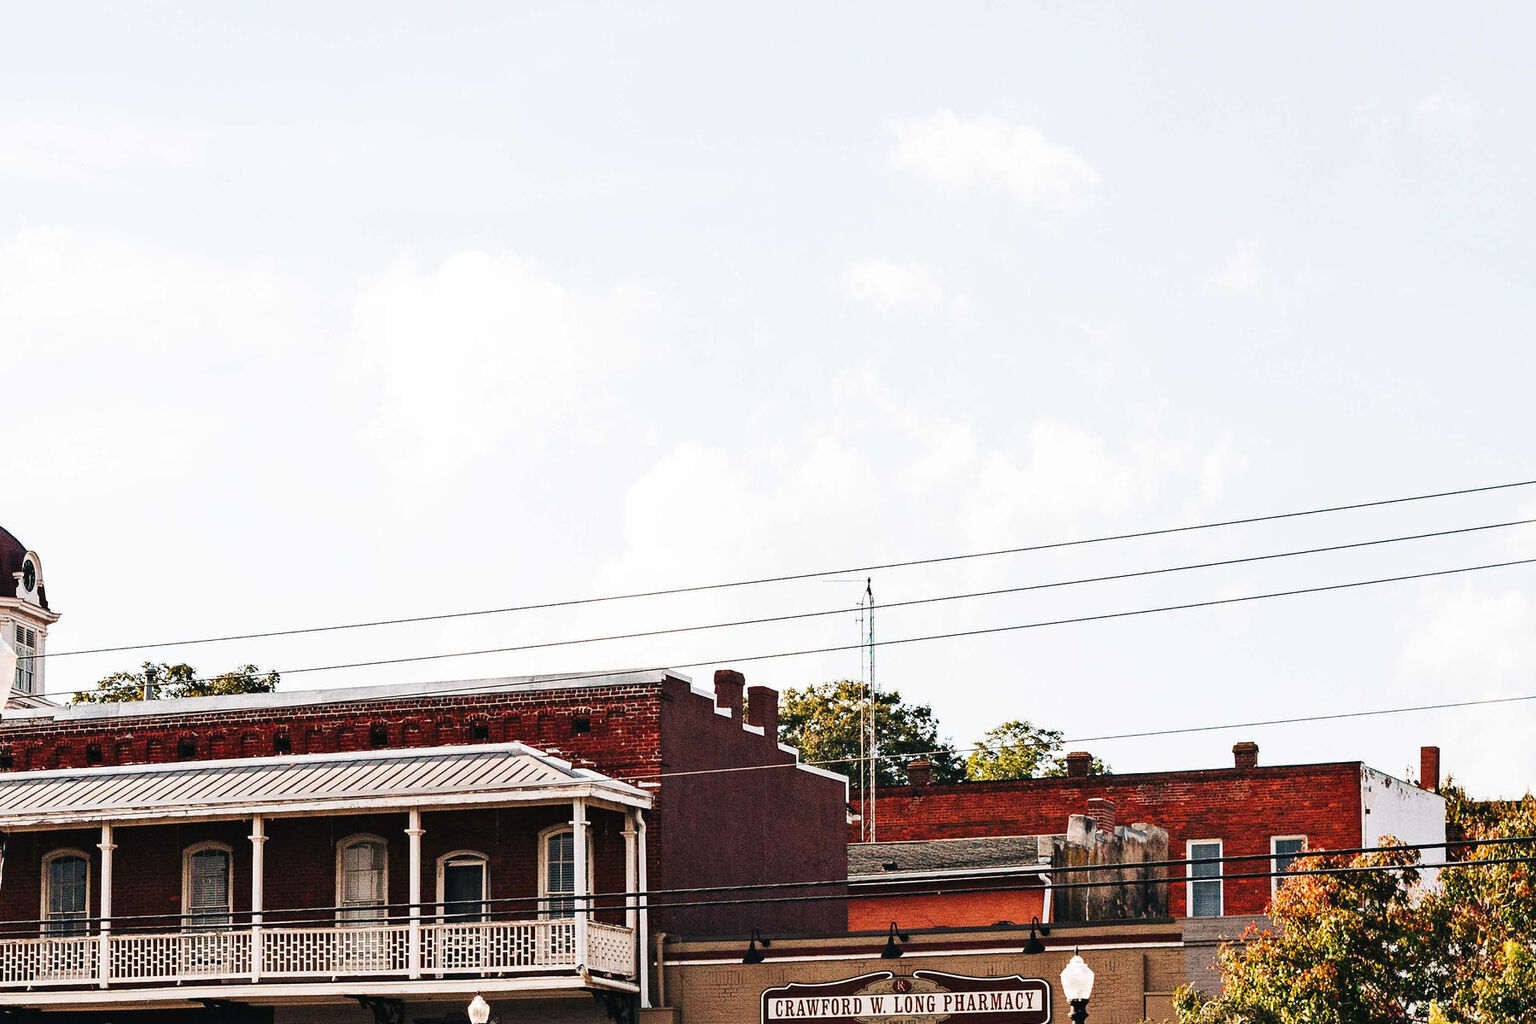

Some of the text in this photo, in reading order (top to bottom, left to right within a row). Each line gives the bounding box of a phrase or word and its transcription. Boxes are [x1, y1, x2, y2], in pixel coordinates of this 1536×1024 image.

[775, 992, 1035, 1017] CRAWFORD W. LONG PHARMACY
